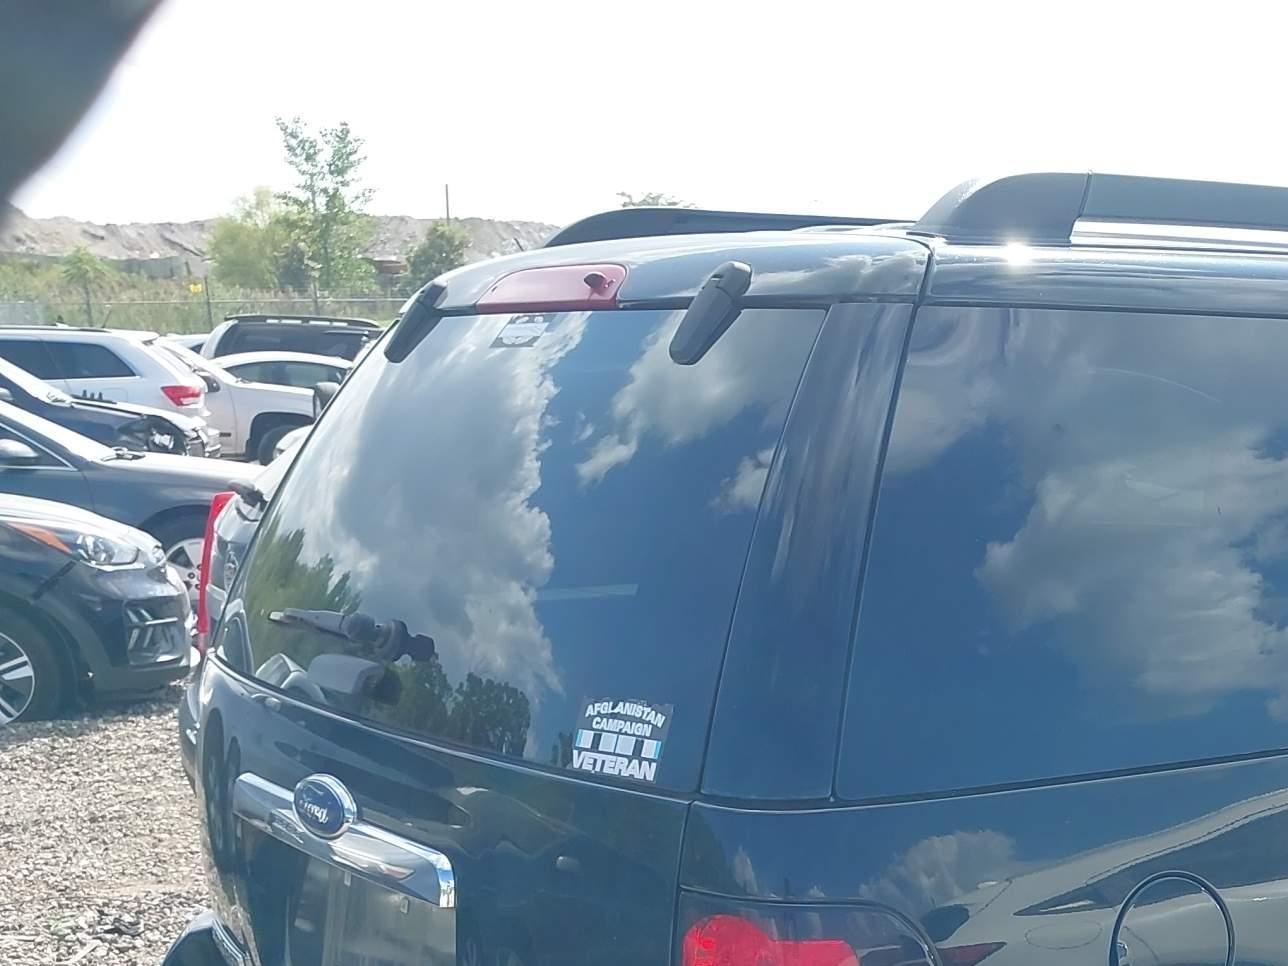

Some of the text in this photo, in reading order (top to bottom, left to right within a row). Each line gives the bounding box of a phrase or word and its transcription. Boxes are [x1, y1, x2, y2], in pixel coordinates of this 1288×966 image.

[585, 701, 666, 728] AFGLANISTAN
[592, 716, 652, 737] CAMPAIGN
[572, 749, 657, 781] VETERAN
